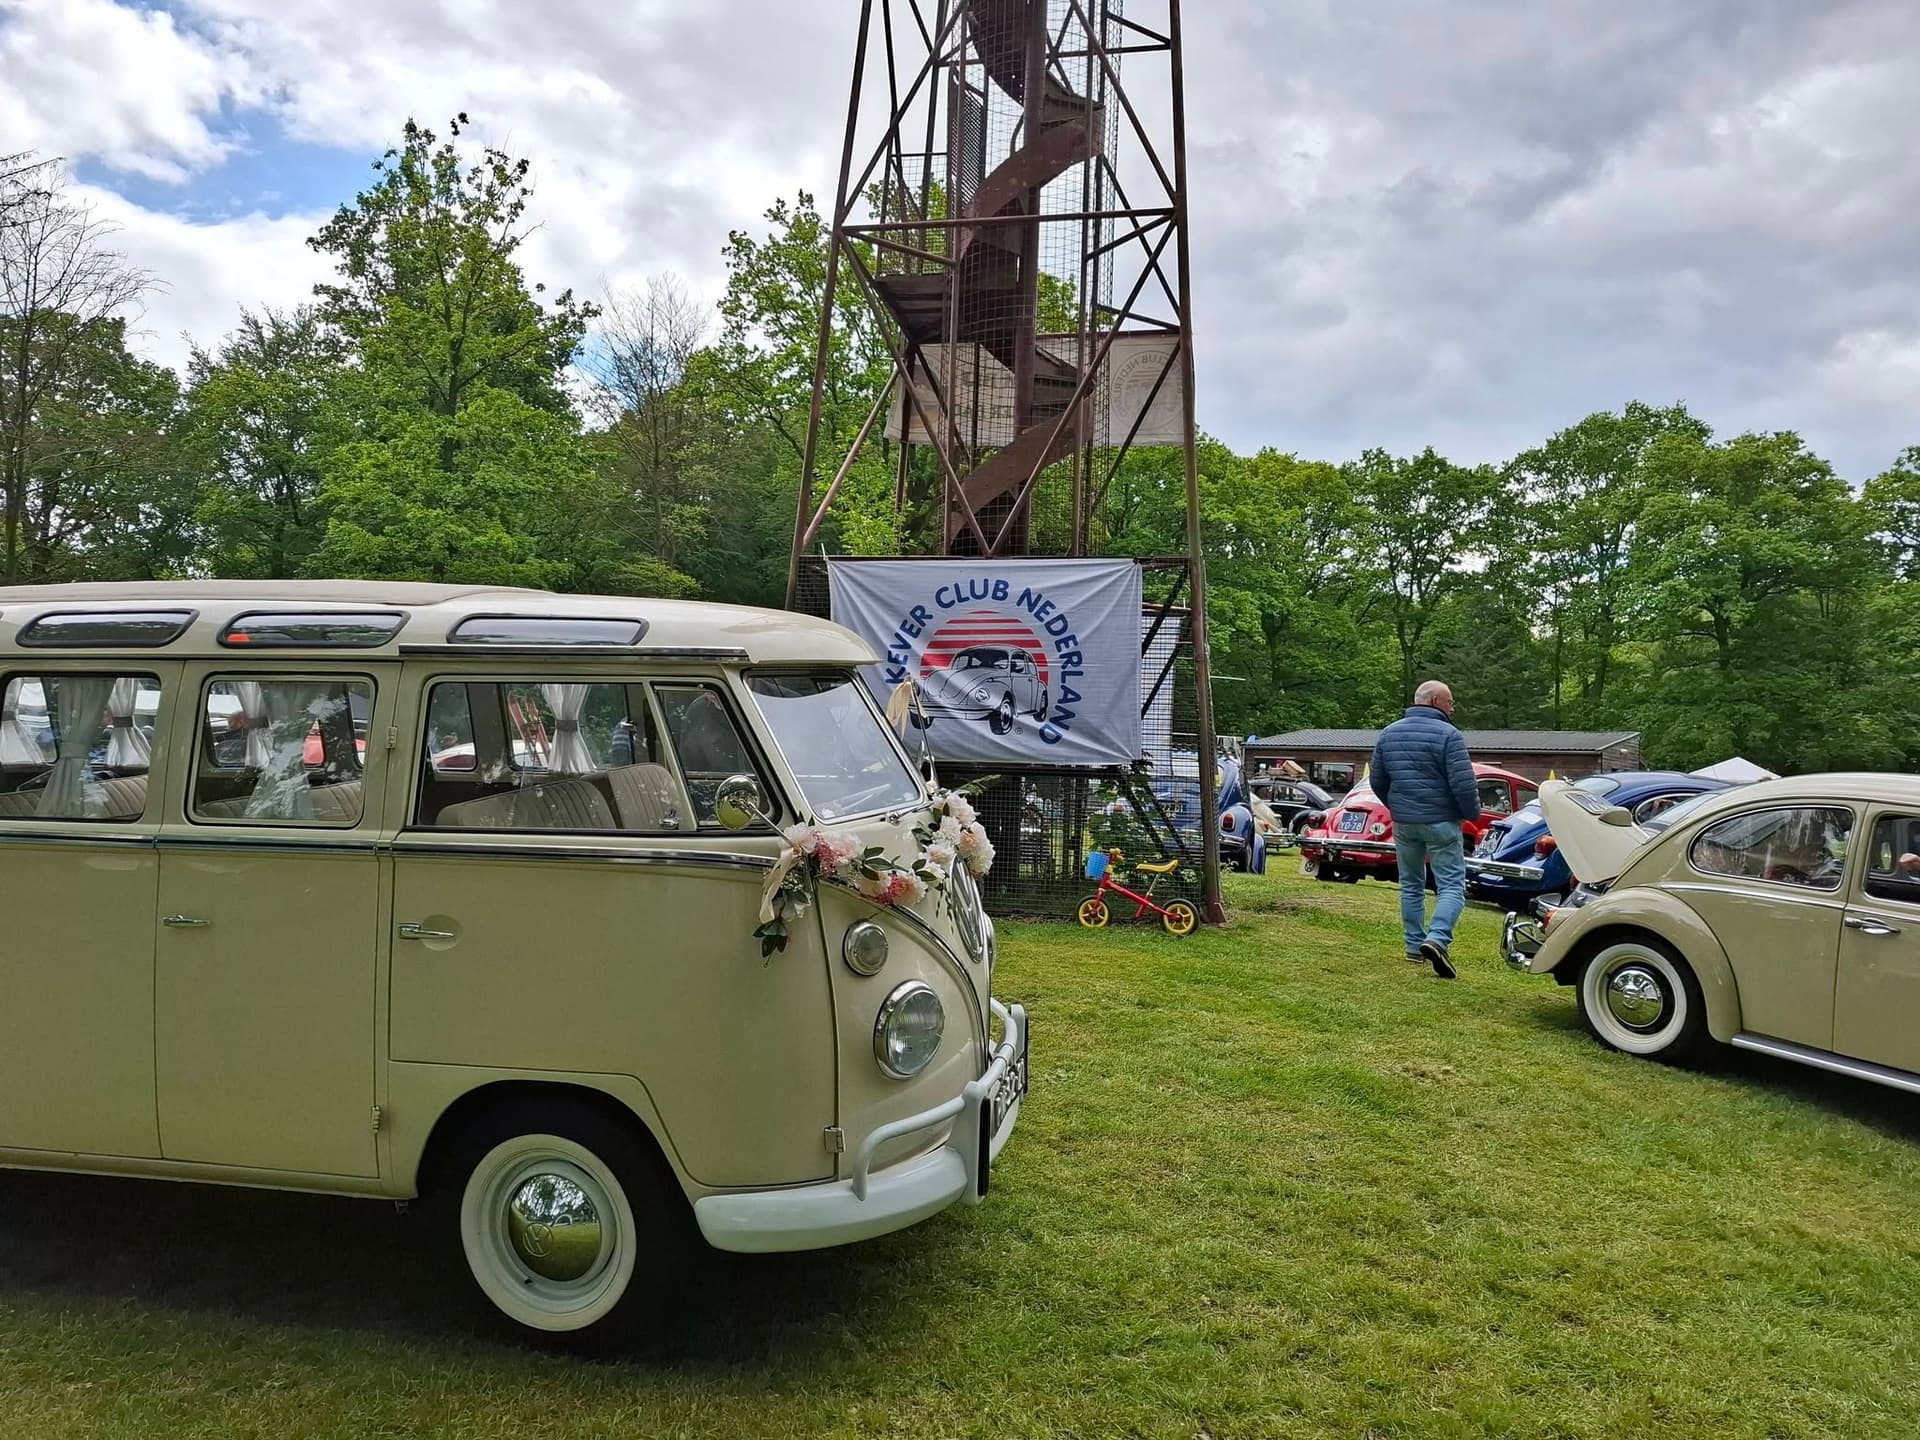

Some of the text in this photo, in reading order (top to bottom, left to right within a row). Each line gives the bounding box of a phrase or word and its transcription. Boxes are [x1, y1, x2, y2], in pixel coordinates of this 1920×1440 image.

[885, 578, 1084, 745] KEVER CLUB NEDERLAND
